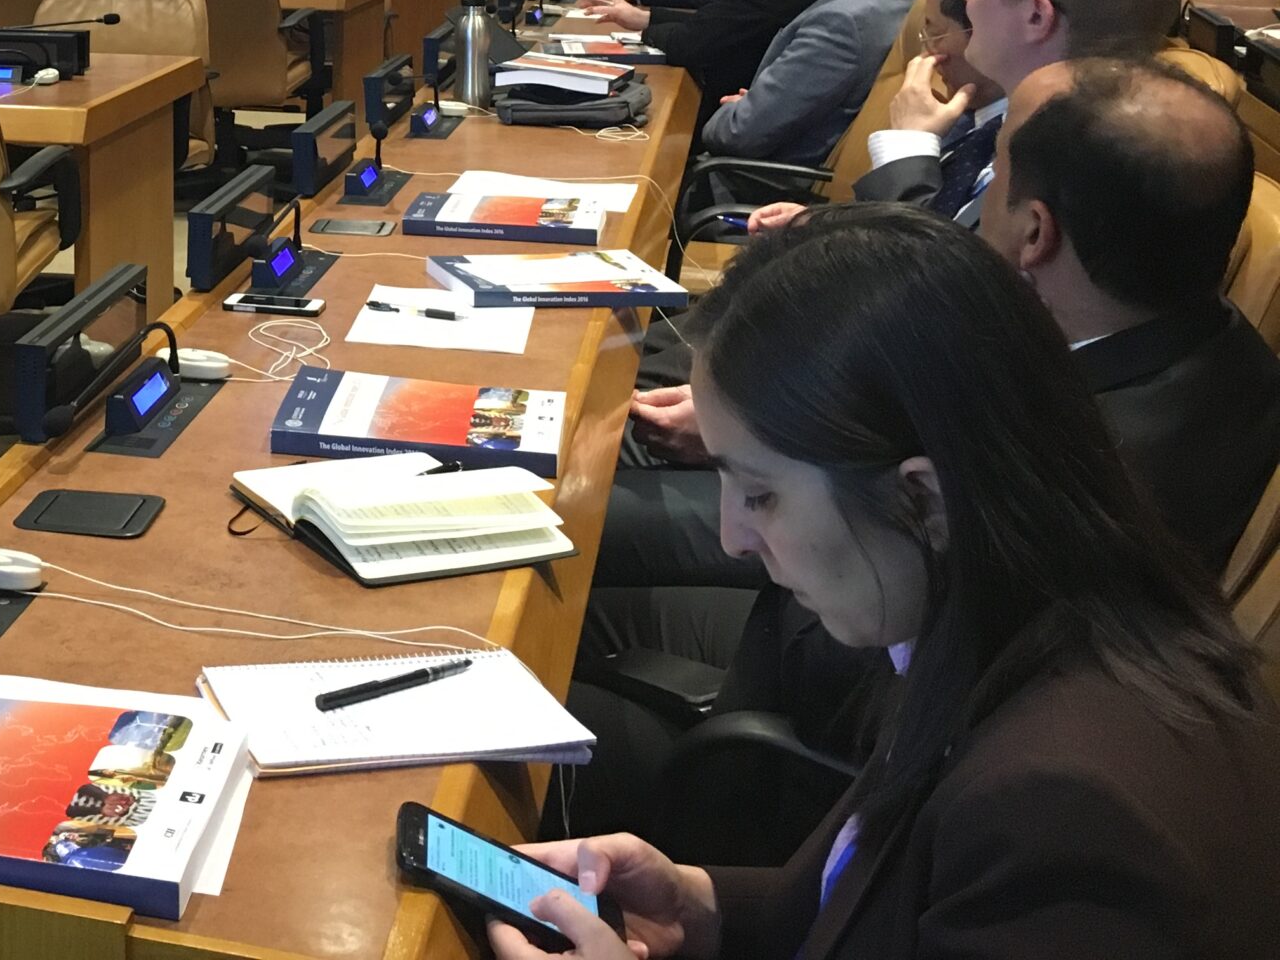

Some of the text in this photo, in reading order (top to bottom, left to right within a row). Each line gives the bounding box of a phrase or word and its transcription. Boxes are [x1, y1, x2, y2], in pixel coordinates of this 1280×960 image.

[319, 442, 330, 450] The
[331, 442, 351, 451] Global
[352, 444, 385, 454] Innovation
